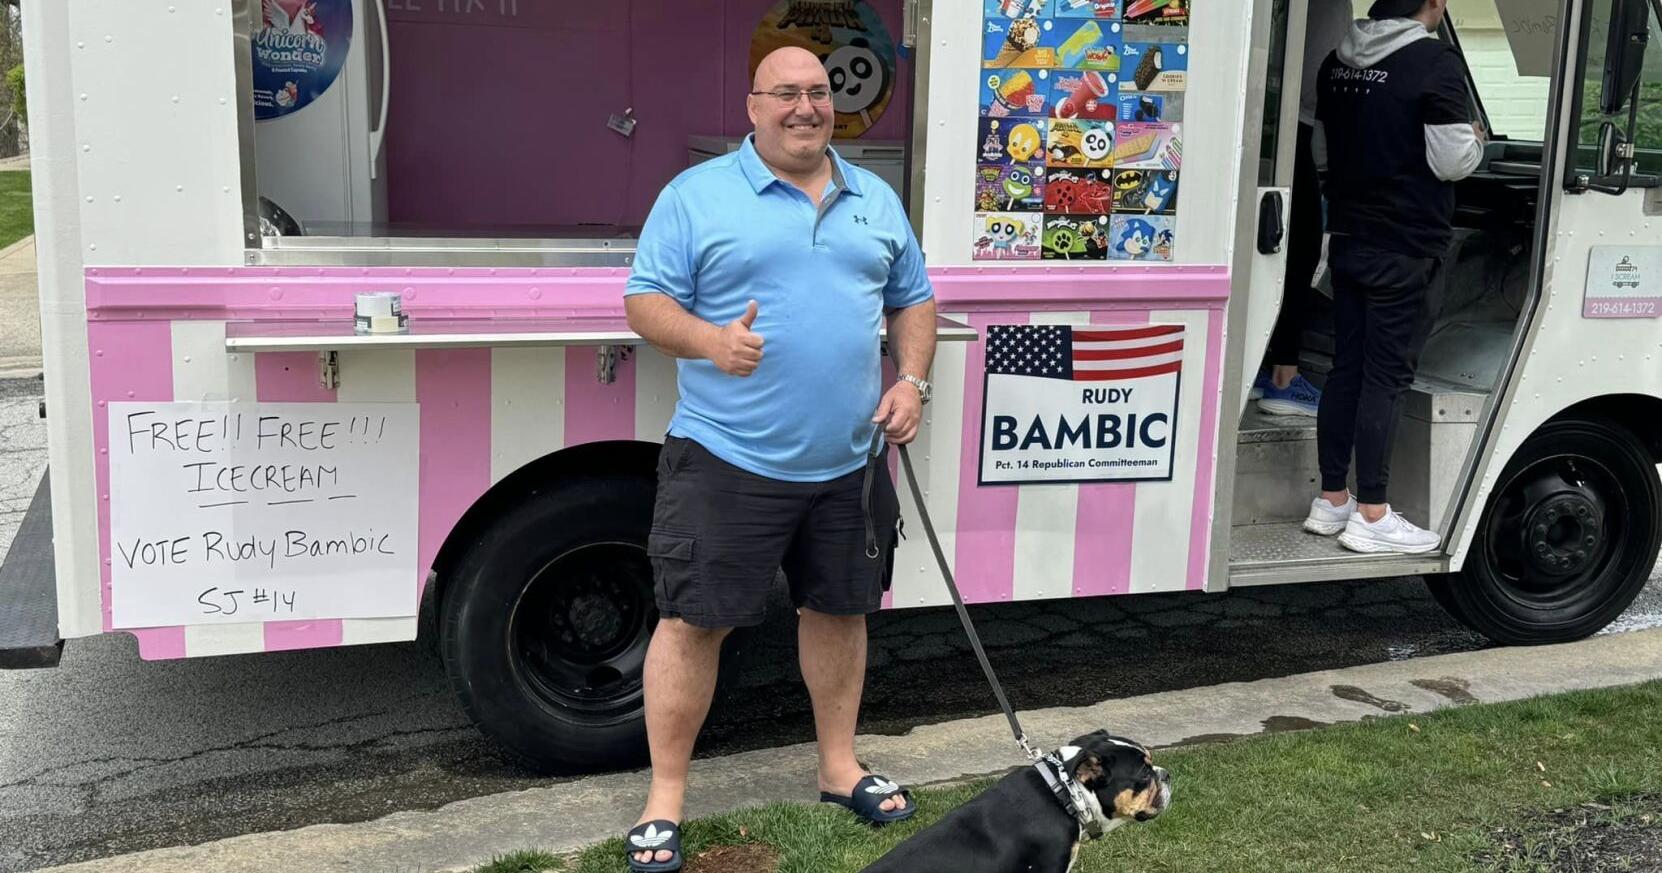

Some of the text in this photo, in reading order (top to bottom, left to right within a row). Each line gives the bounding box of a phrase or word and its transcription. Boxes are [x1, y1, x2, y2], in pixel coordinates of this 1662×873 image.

[255, 28, 325, 53] Unicorn
[1591, 302, 1655, 314] 219-614-1372
[1082, 388, 1133, 404] RUDY
[127, 411, 386, 454] FREE!! FREE!!!
[991, 412, 1168, 451] BAMBIC
[182, 461, 338, 493] ICECREAM
[995, 458, 1158, 471] Pct. 14 Republican Committeeman
[117, 528, 396, 569] VOTE Rudy Bambic
[197, 587, 296, 615] SJ #14
